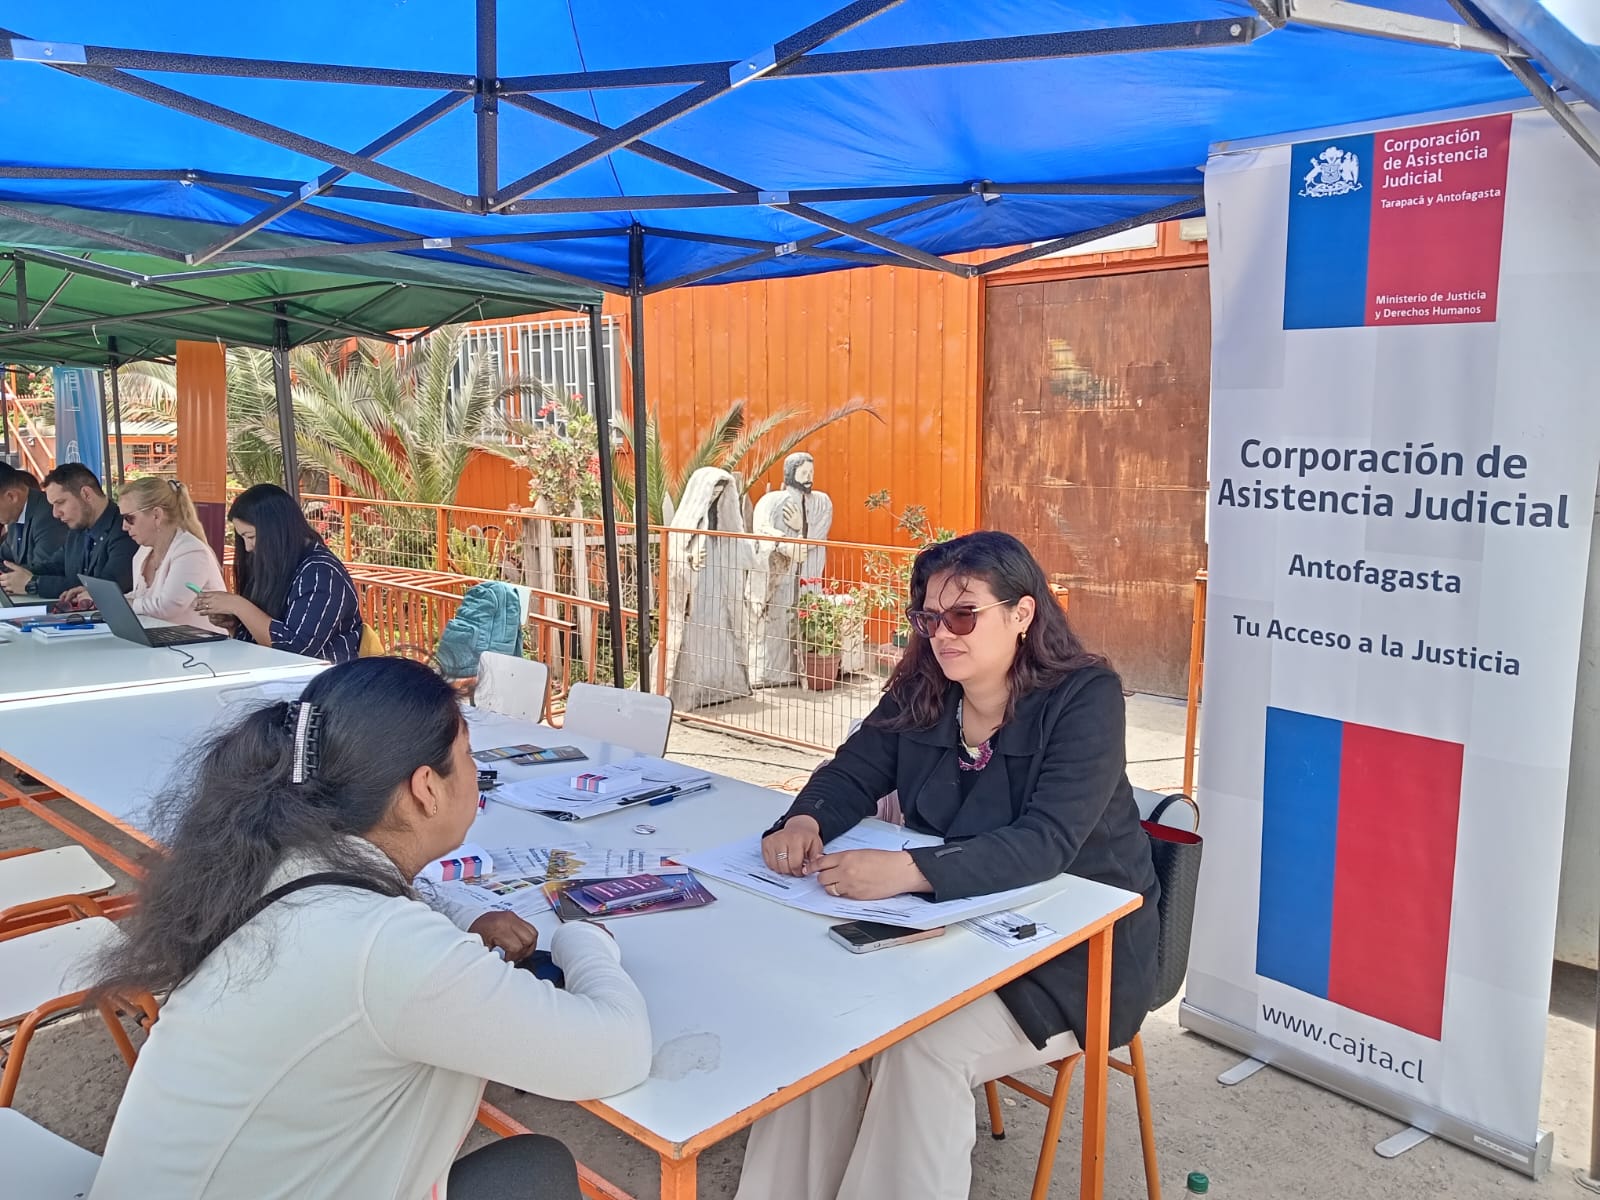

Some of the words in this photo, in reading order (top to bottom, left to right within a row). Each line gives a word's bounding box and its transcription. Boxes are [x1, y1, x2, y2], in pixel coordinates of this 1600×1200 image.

[1384, 128, 1480, 153] Corporación
[1383, 156, 1402, 171] de
[1406, 145, 1488, 168] Asistencia
[1382, 169, 1442, 188] Judicial
[1380, 195, 1425, 209] Tarapacá
[1426, 196, 1434, 207] y
[1435, 188, 1501, 203] Antofagasta
[1375, 293, 1428, 305] Ministerio
[1430, 292, 1444, 302] de
[1445, 290, 1487, 301] Justicia
[1374, 311, 1381, 320] y
[1383, 307, 1430, 318] Derechos
[1432, 306, 1481, 316] Humanos
[1241, 439, 1463, 477] Corporación
[1477, 445, 1527, 479] de
[1217, 478, 1394, 516] Asistencia
[1405, 488, 1569, 528] Judicial
[1289, 555, 1460, 593] Antofagasta
[1234, 615, 1259, 636] Tu
[1267, 620, 1350, 649] Acceso
[1359, 638, 1372, 653] a
[1382, 634, 1403, 657] la
[1412, 640, 1519, 675] Justicia
[1262, 1003, 1424, 1083] www.cajta.cl
